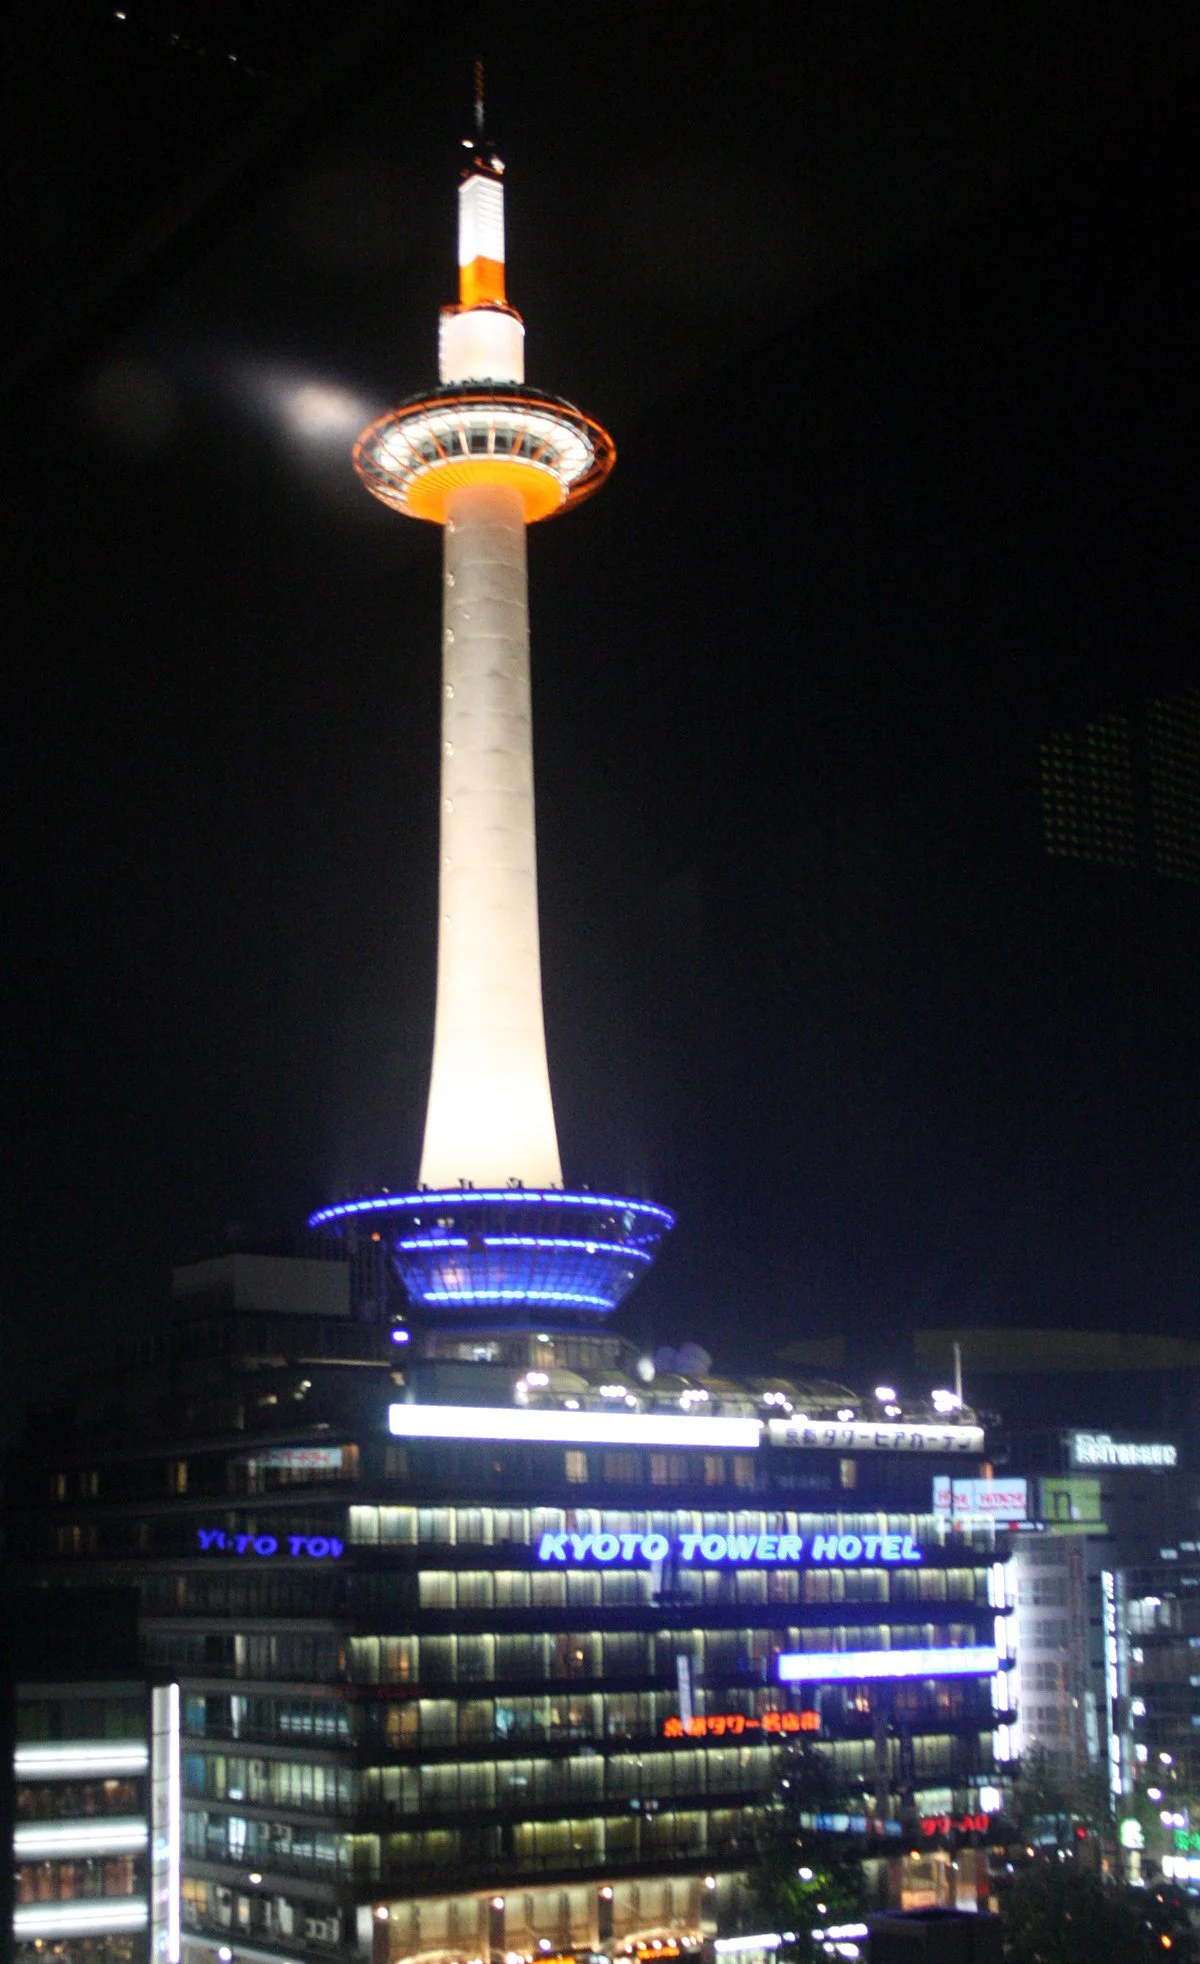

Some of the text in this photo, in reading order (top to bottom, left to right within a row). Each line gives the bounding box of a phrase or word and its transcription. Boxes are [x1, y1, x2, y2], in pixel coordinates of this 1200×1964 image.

[538, 1533, 922, 1562] KYOTO TOWER HOTEL
